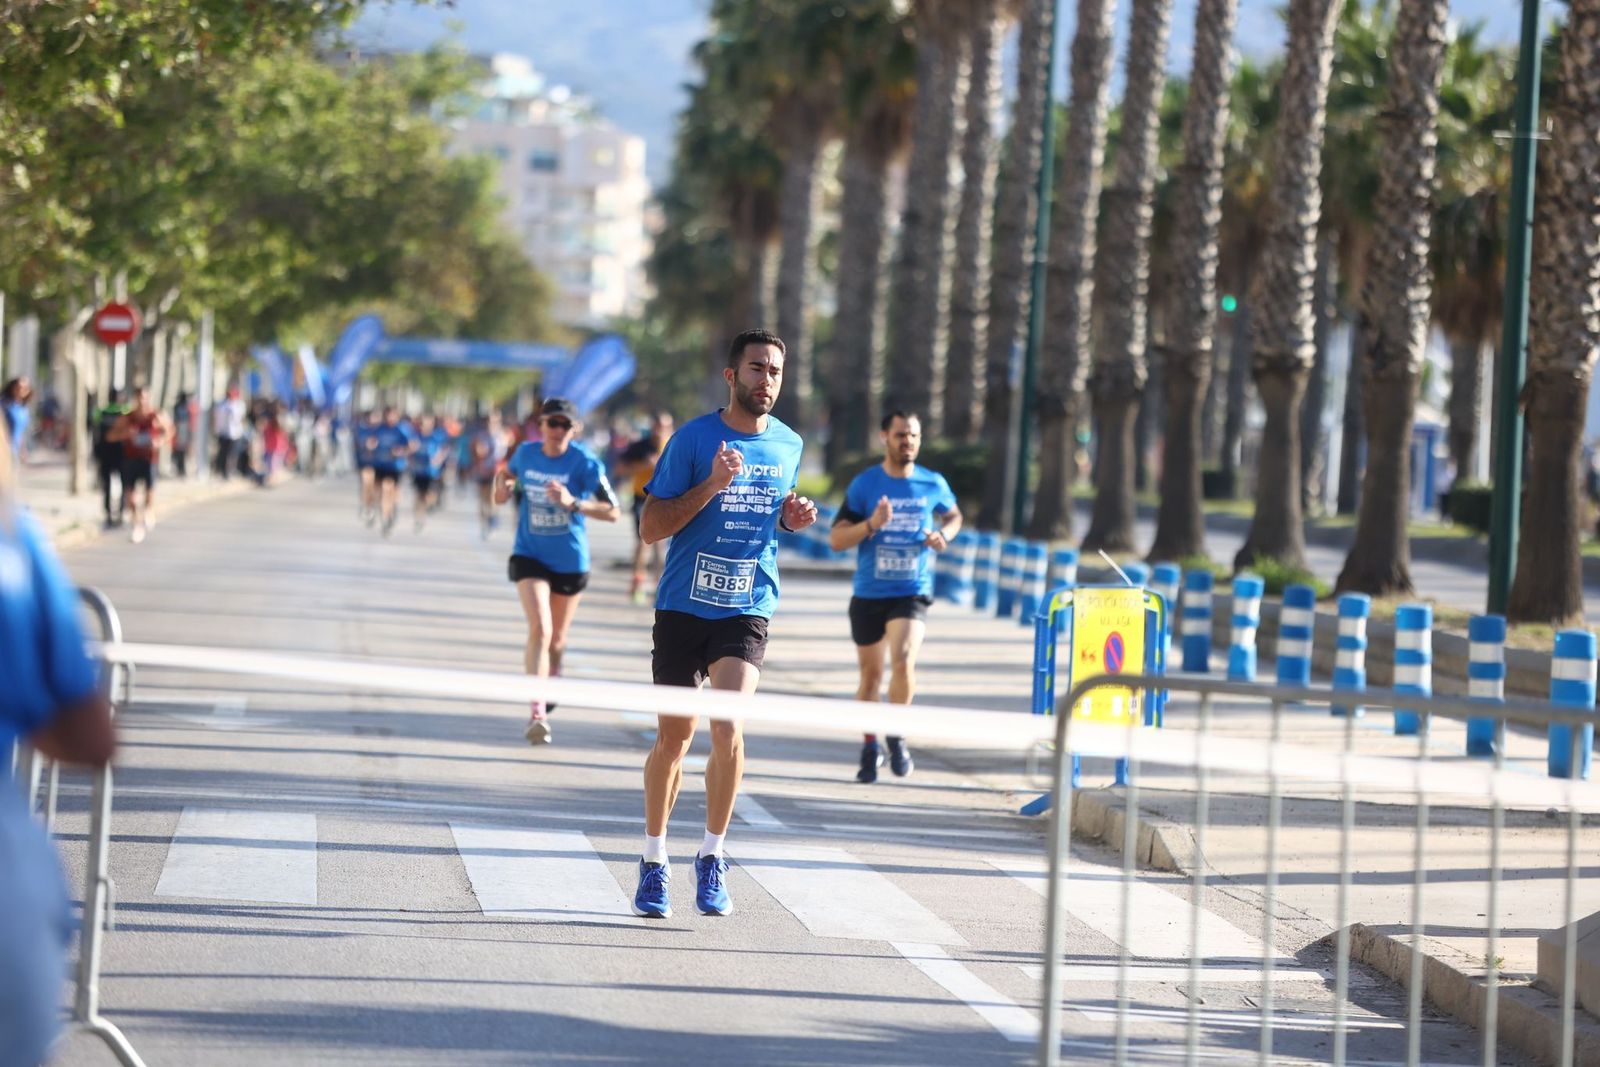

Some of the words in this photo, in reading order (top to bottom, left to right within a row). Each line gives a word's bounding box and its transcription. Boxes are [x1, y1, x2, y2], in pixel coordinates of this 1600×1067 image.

[724, 494, 773, 505] MAKES
[721, 504, 773, 514] FRIENDS
[703, 573, 747, 591] 1983
